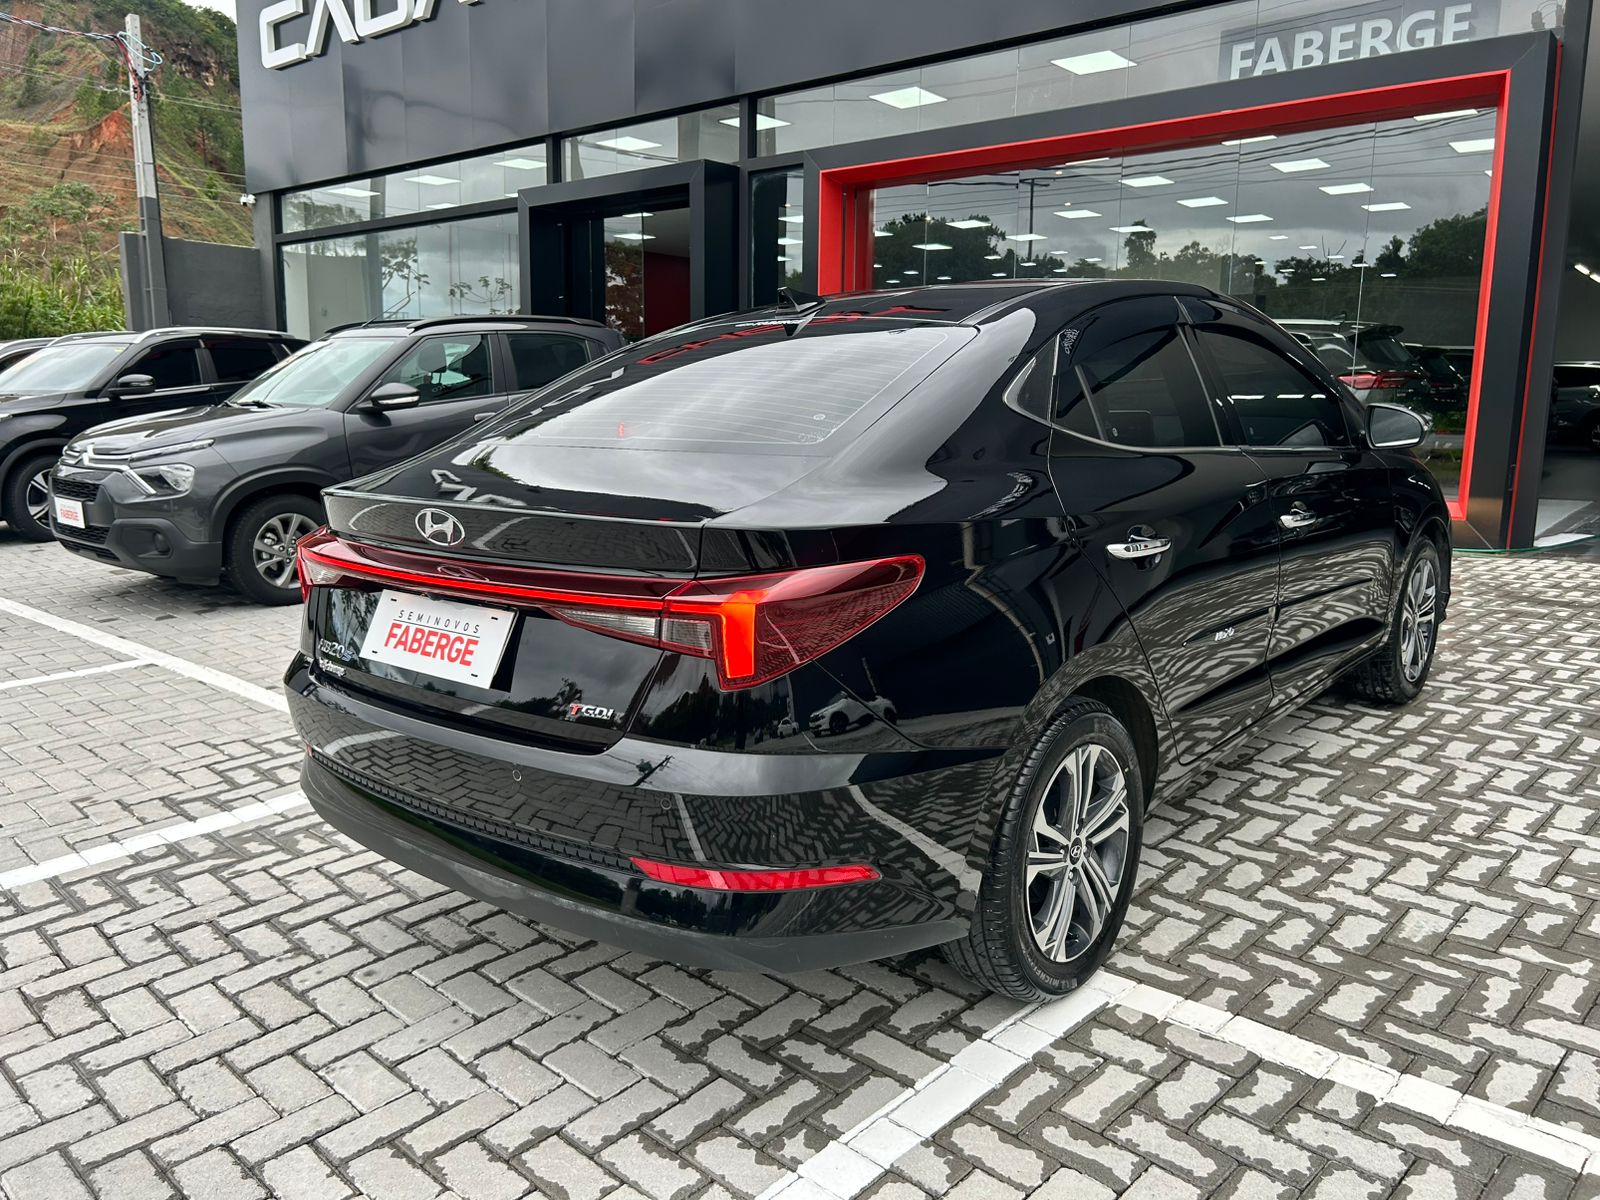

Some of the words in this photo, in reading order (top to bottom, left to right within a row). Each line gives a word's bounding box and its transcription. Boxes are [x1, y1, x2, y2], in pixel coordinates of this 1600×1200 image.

[1230, 3, 1472, 81] FABERGE
[398, 609, 480, 634] SEMINOVOS
[384, 622, 479, 667] FABERGE
